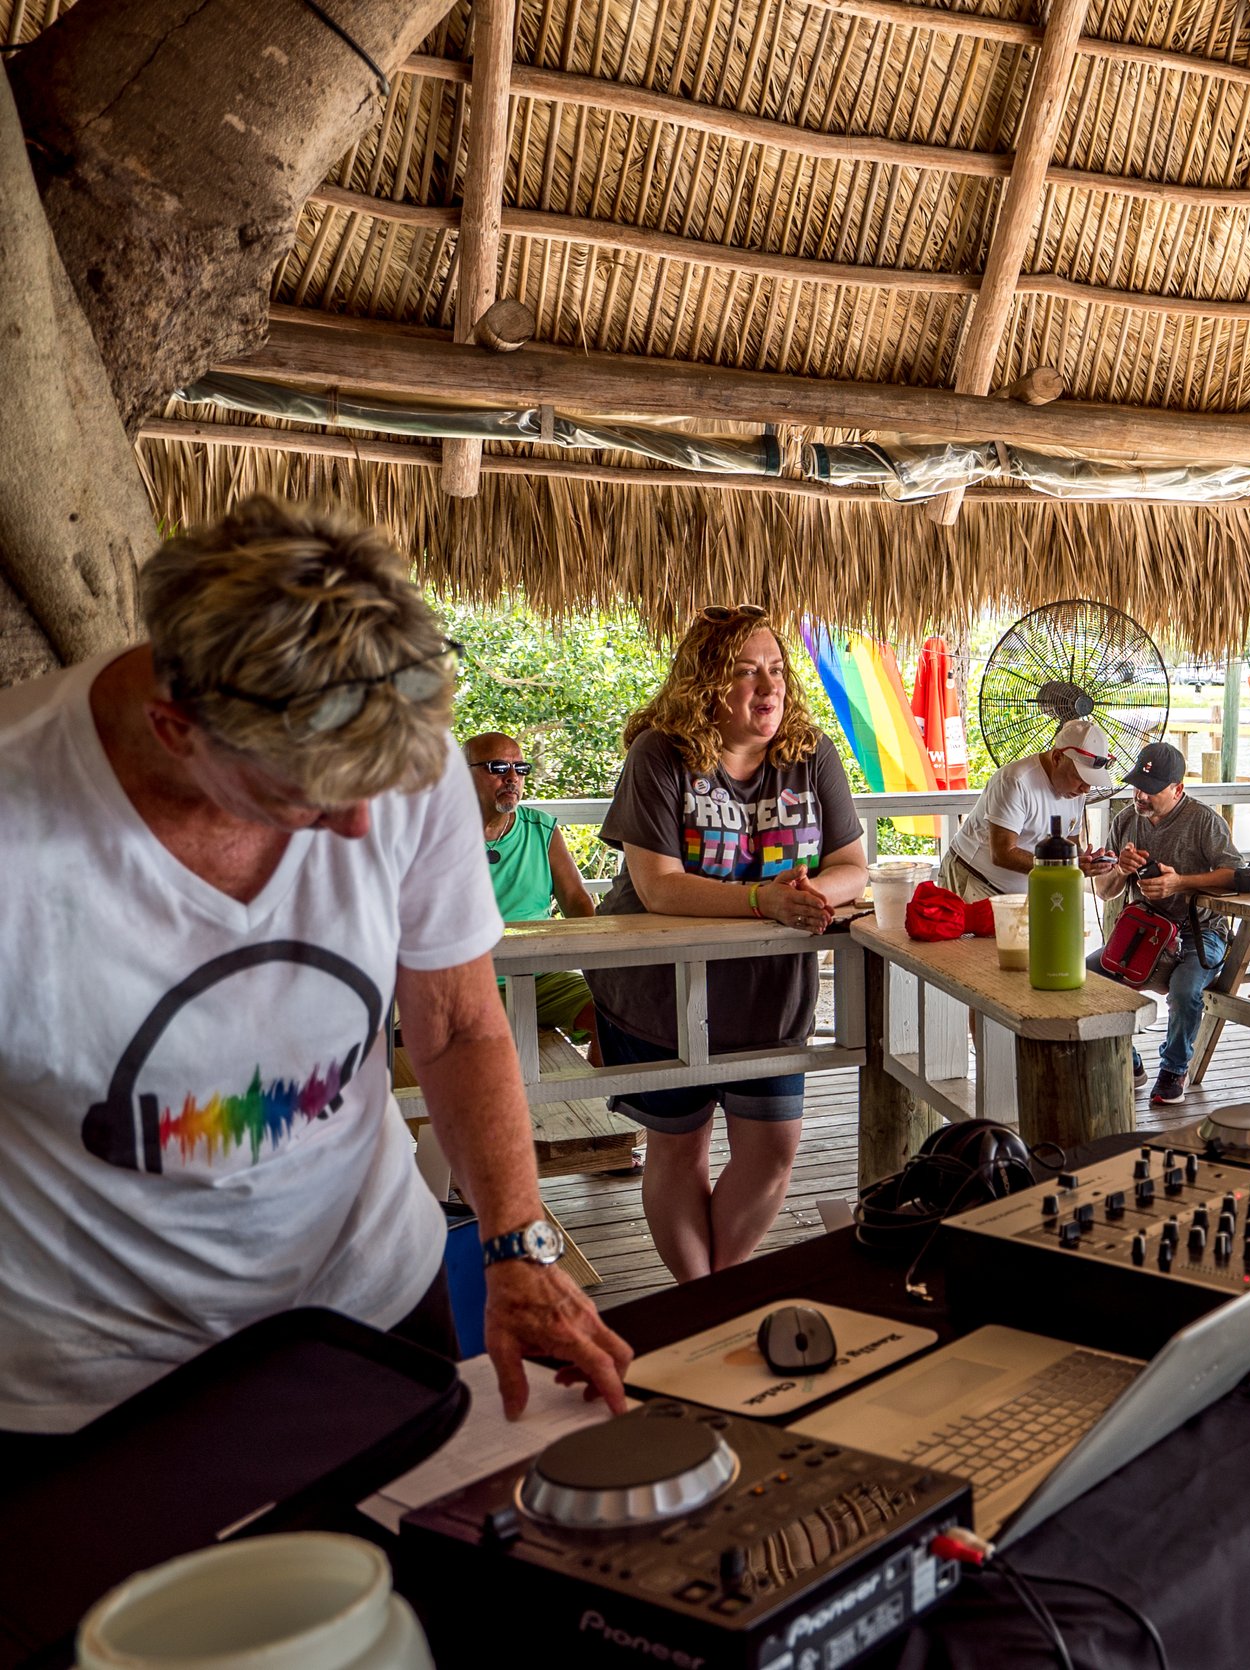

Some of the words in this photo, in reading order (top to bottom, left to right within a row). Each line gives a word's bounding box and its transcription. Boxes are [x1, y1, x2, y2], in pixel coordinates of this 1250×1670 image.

[683, 791, 817, 833] PROTECT
[579, 1609, 706, 1670] Pioneer
[786, 1574, 881, 1647] Pioneer
